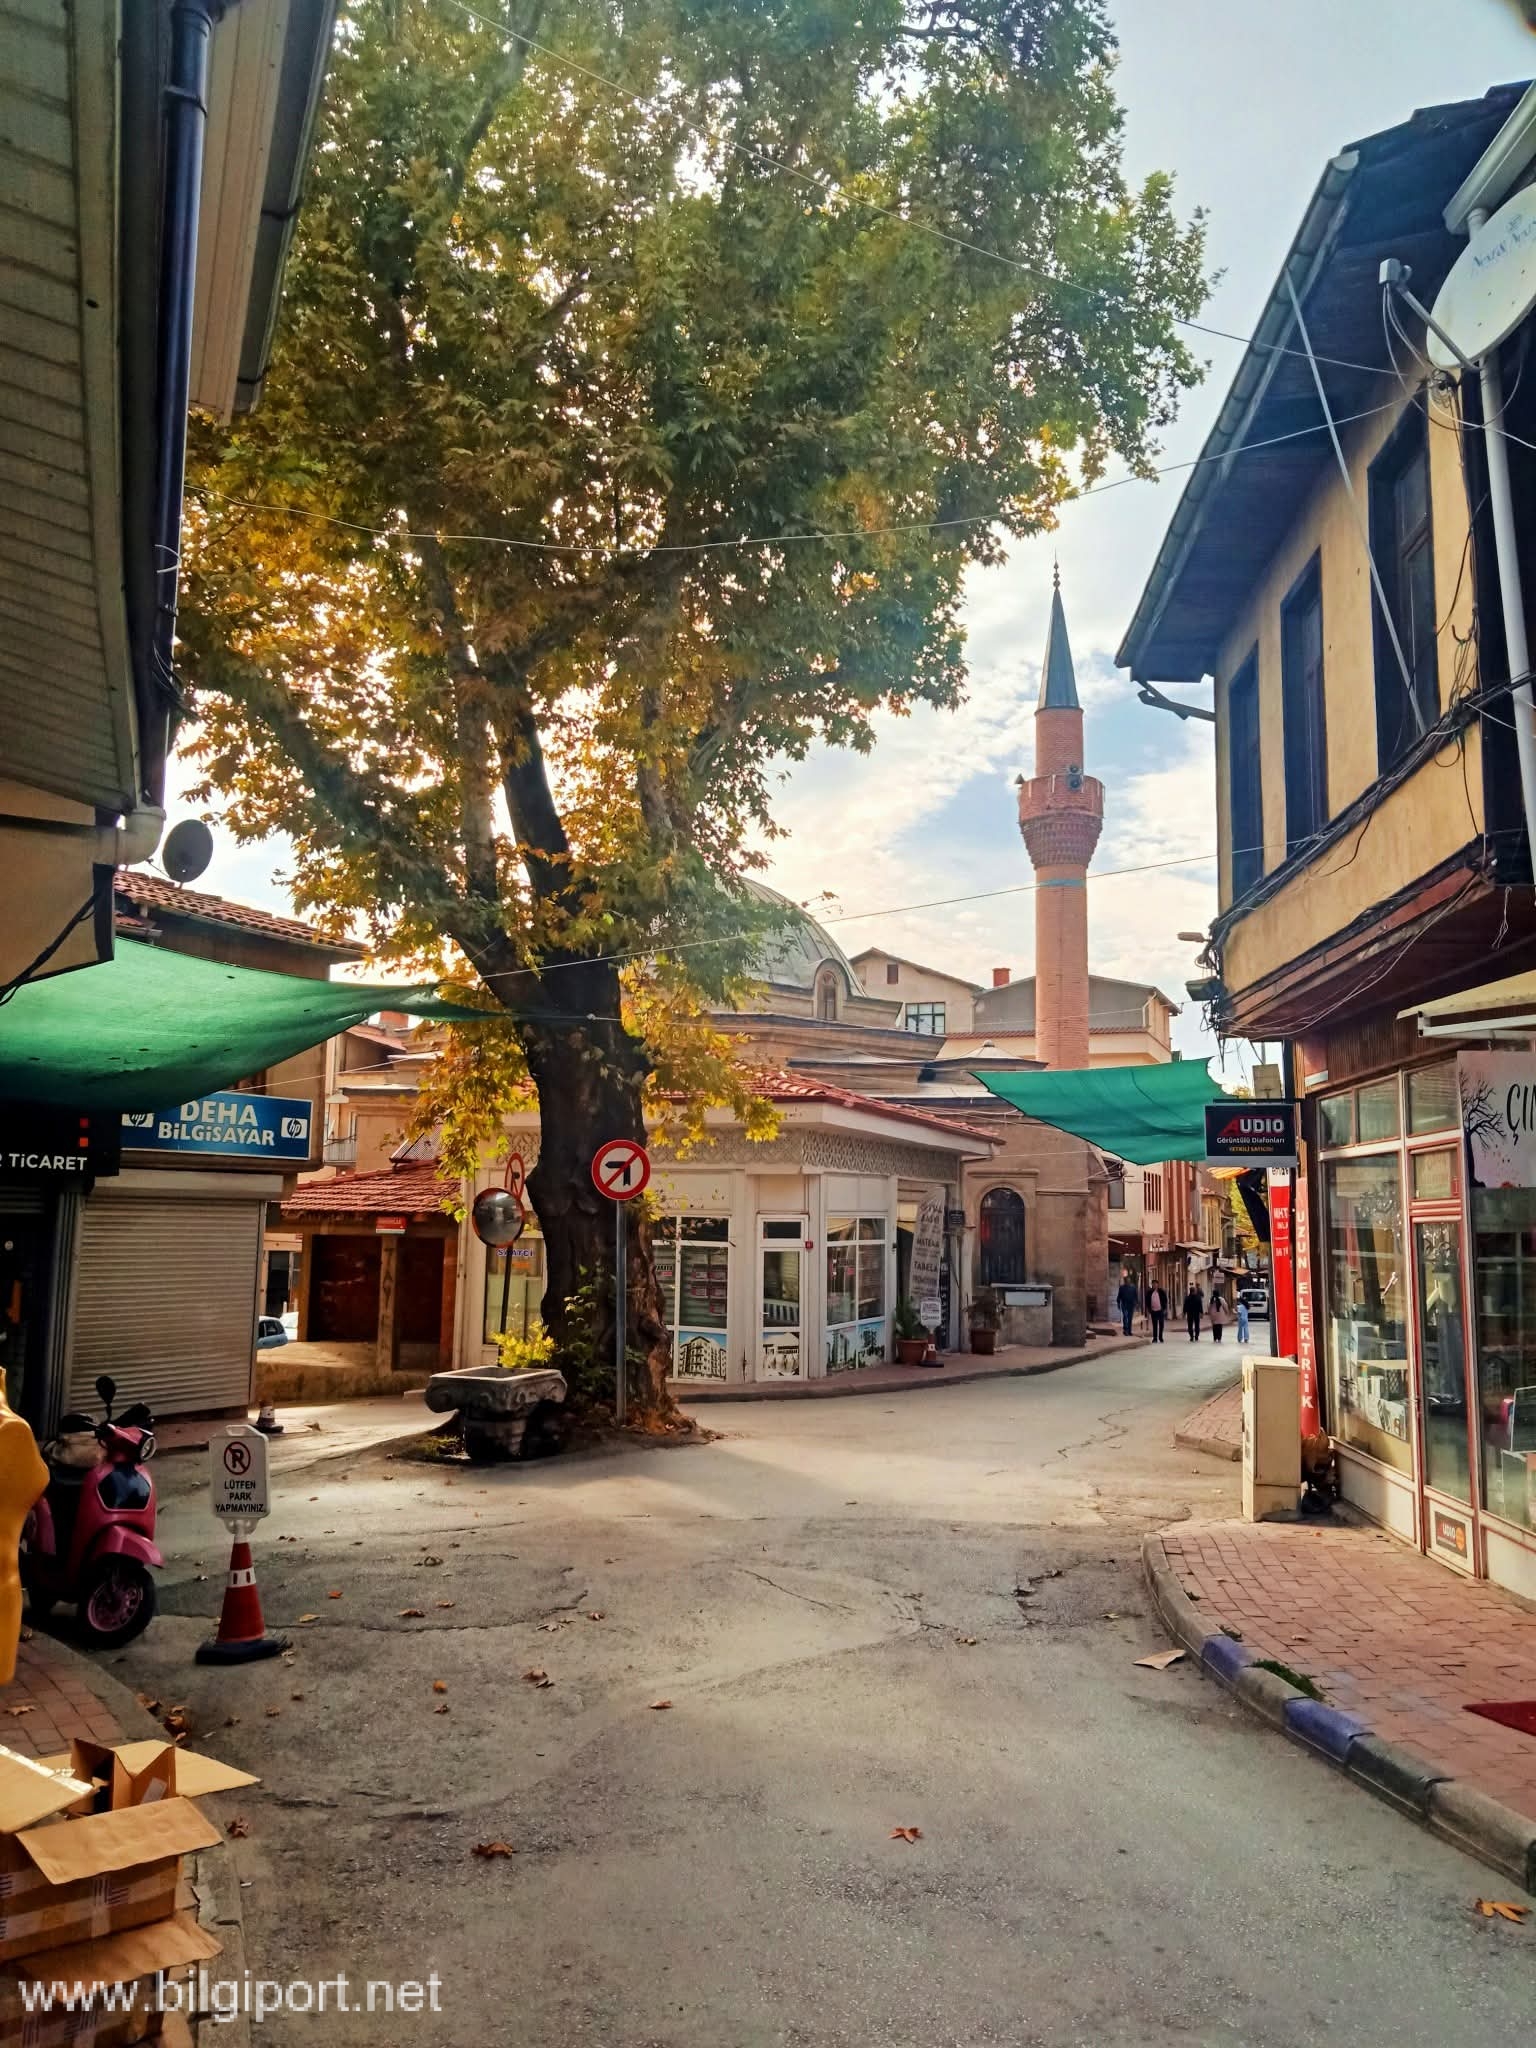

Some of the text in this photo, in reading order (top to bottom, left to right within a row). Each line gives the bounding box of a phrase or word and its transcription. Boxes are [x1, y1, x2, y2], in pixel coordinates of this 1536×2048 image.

[180, 1100, 259, 1127] DEHA
[287, 1117, 303, 1139] hp
[1218, 1115, 1285, 1136] AUDIO
[1216, 1136, 1285, 1144] Görüntülü Diafonları
[1297, 1211, 1308, 1269] UZUN
[224, 1479, 256, 1490] LÜTFEN
[229, 1492, 252, 1501] PARK
